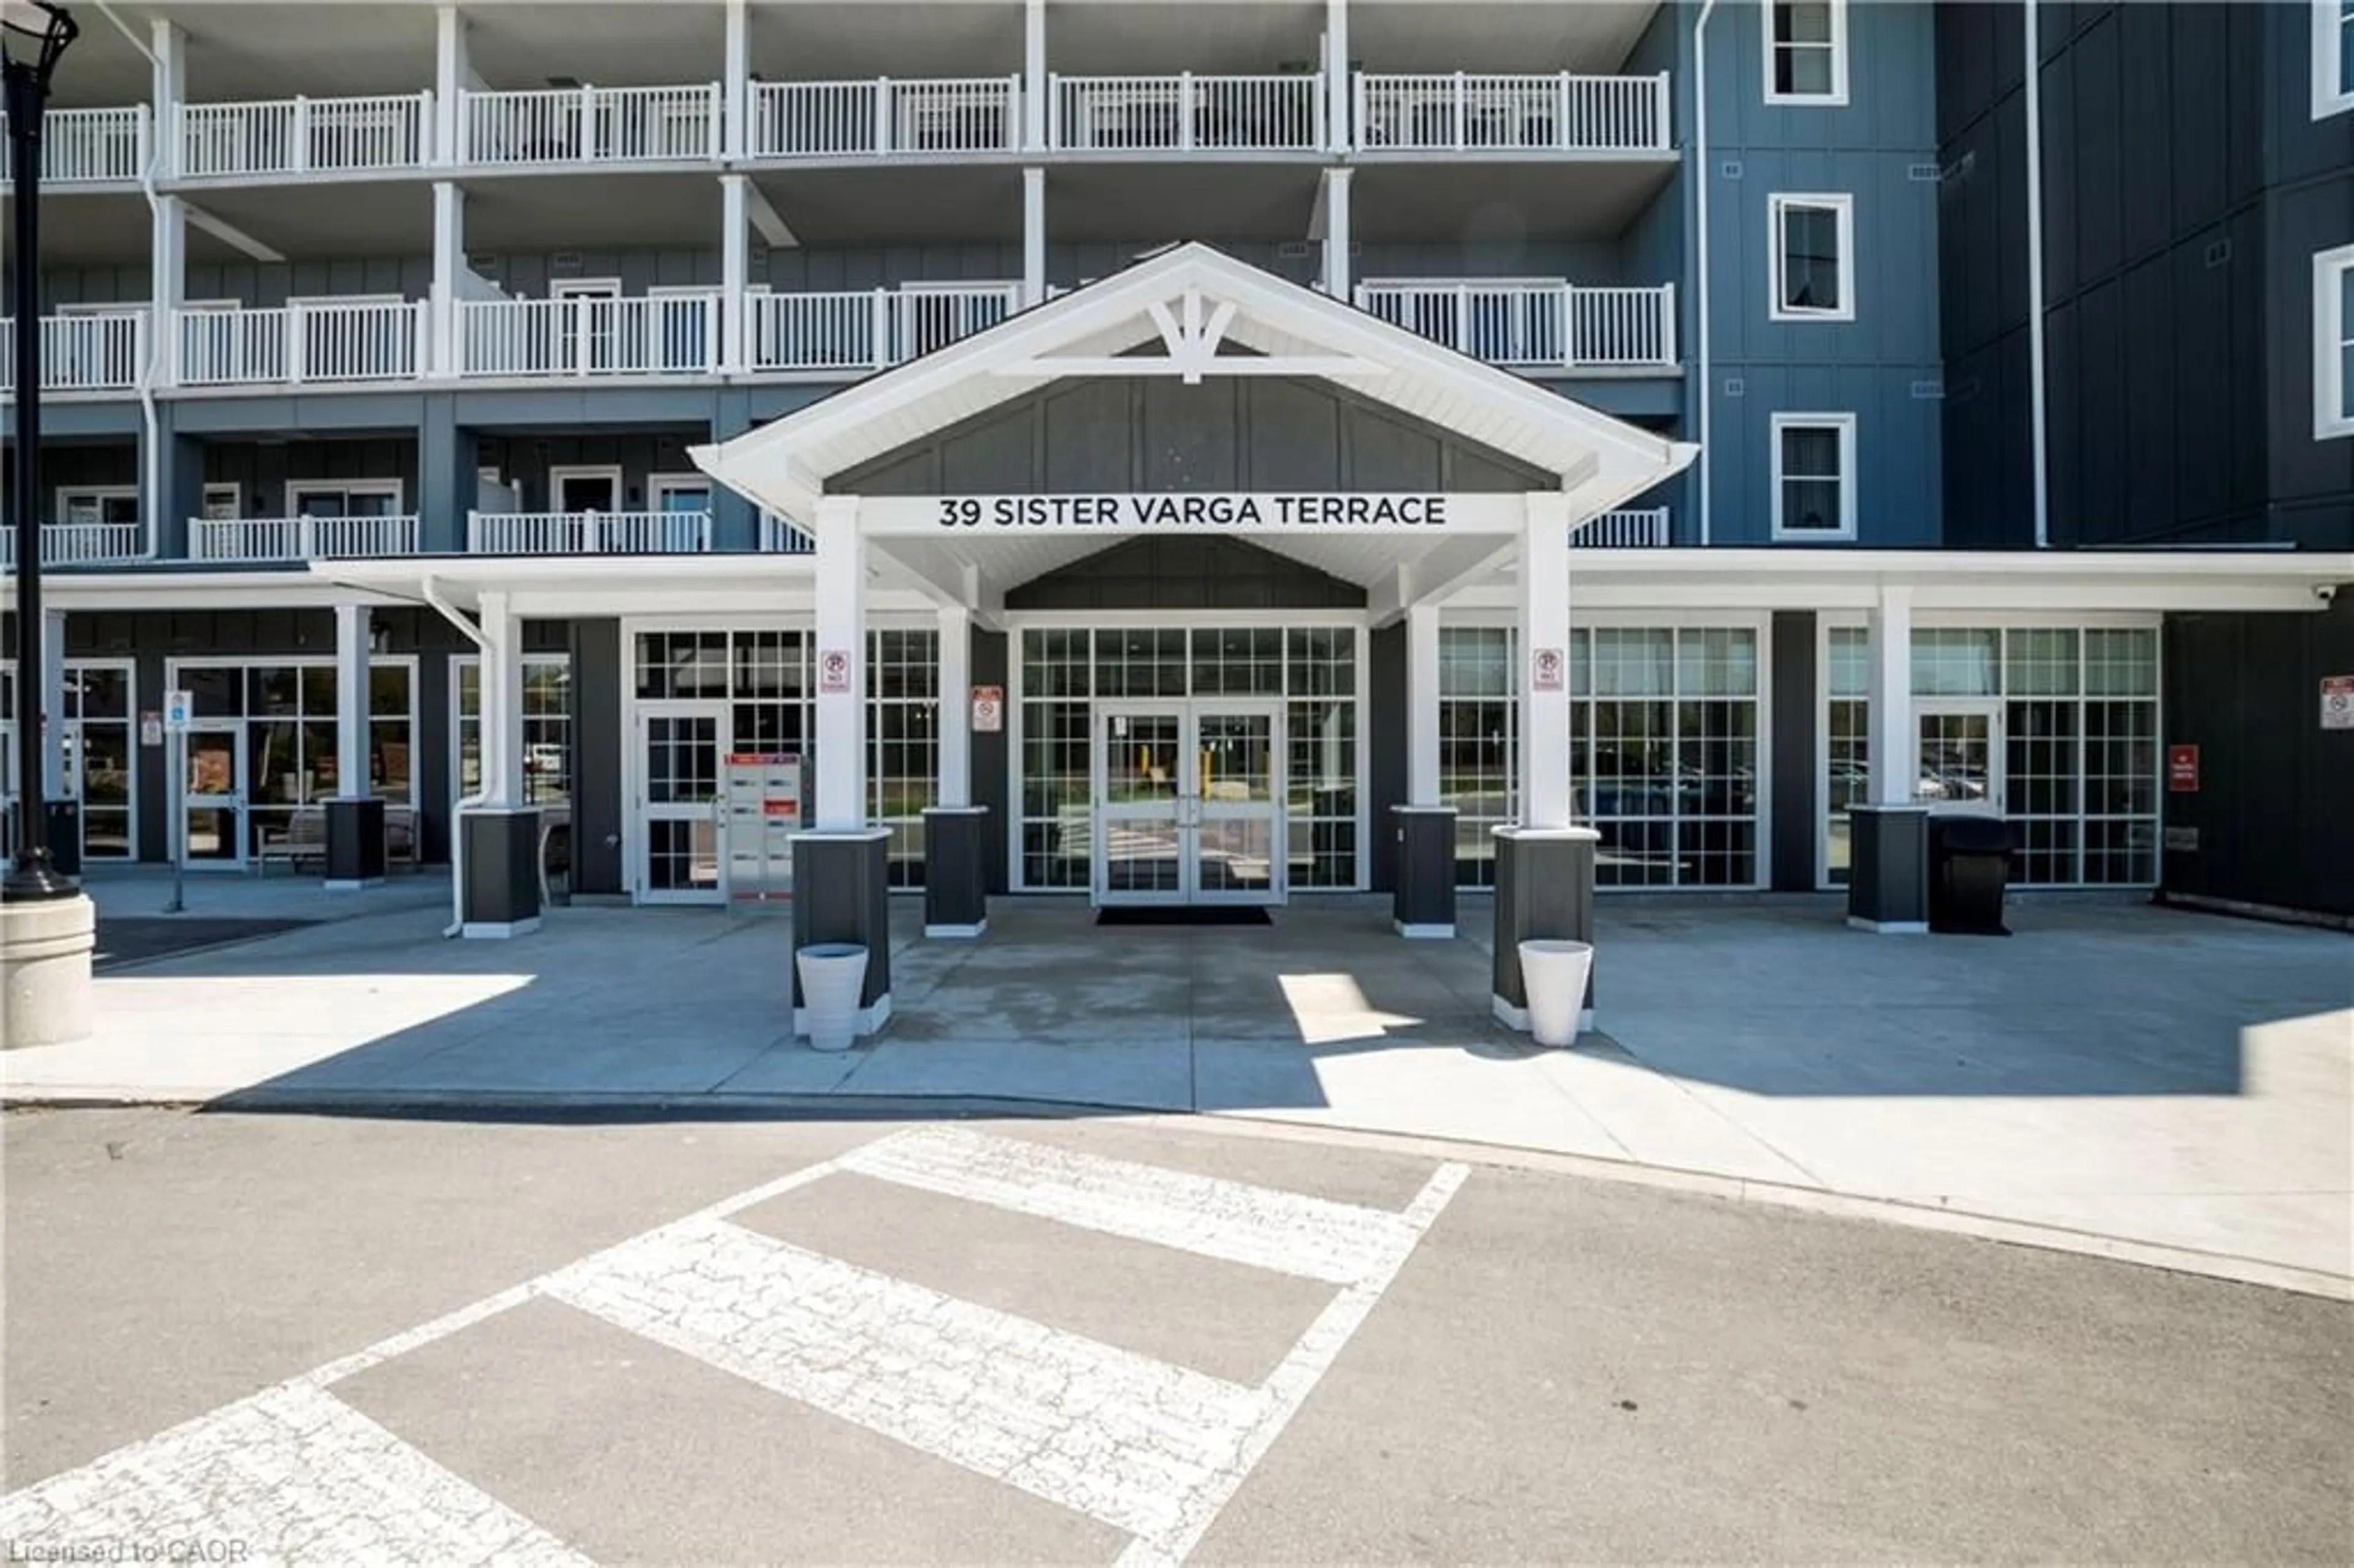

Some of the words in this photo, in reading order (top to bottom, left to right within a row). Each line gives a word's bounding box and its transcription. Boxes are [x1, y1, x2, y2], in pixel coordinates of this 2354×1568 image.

[939, 499, 981, 526] 39
[994, 498, 1119, 525] SISTER
[1132, 497, 1261, 523] VARGA
[1274, 497, 1446, 524] TERRACE
